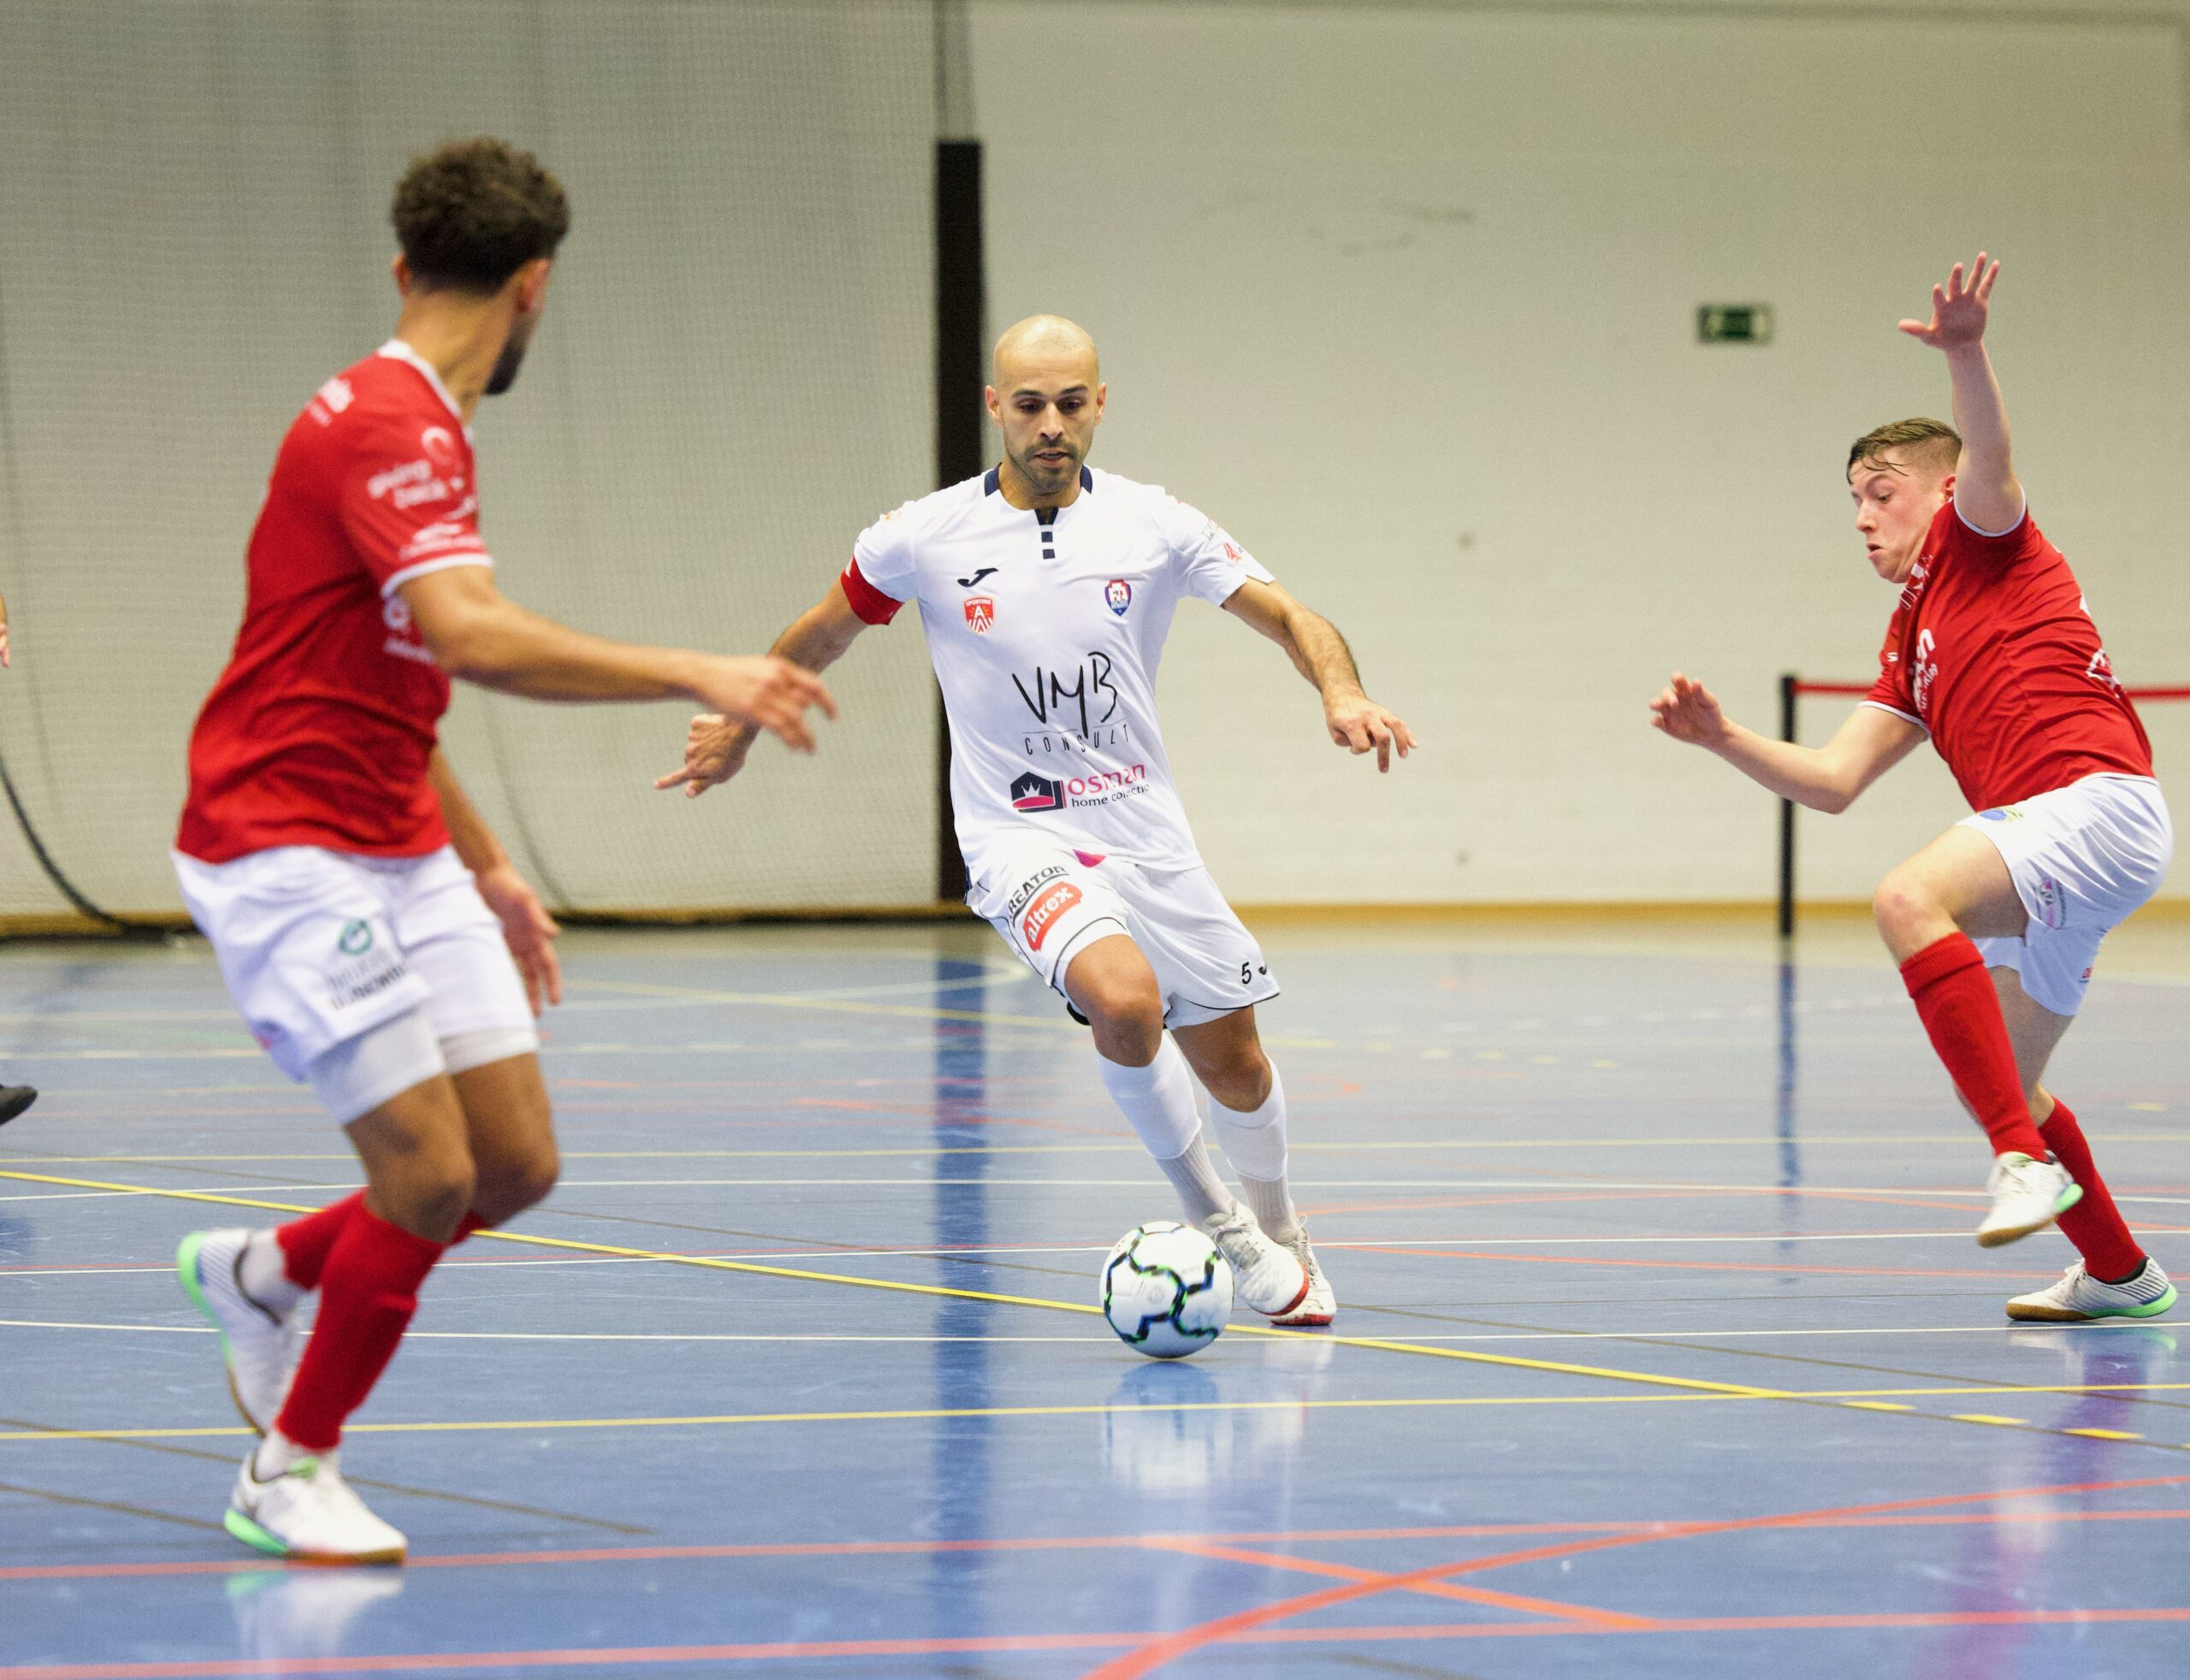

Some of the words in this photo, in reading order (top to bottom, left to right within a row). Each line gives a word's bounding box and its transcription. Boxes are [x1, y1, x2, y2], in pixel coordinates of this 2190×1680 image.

[1011, 651, 1117, 740] VMB
[1024, 724, 1129, 755] CONSULT
[1067, 764, 1145, 796] osman
[1071, 796, 1108, 807] home
[1027, 887, 1074, 943] altrex
[1240, 961, 1252, 985] 5
